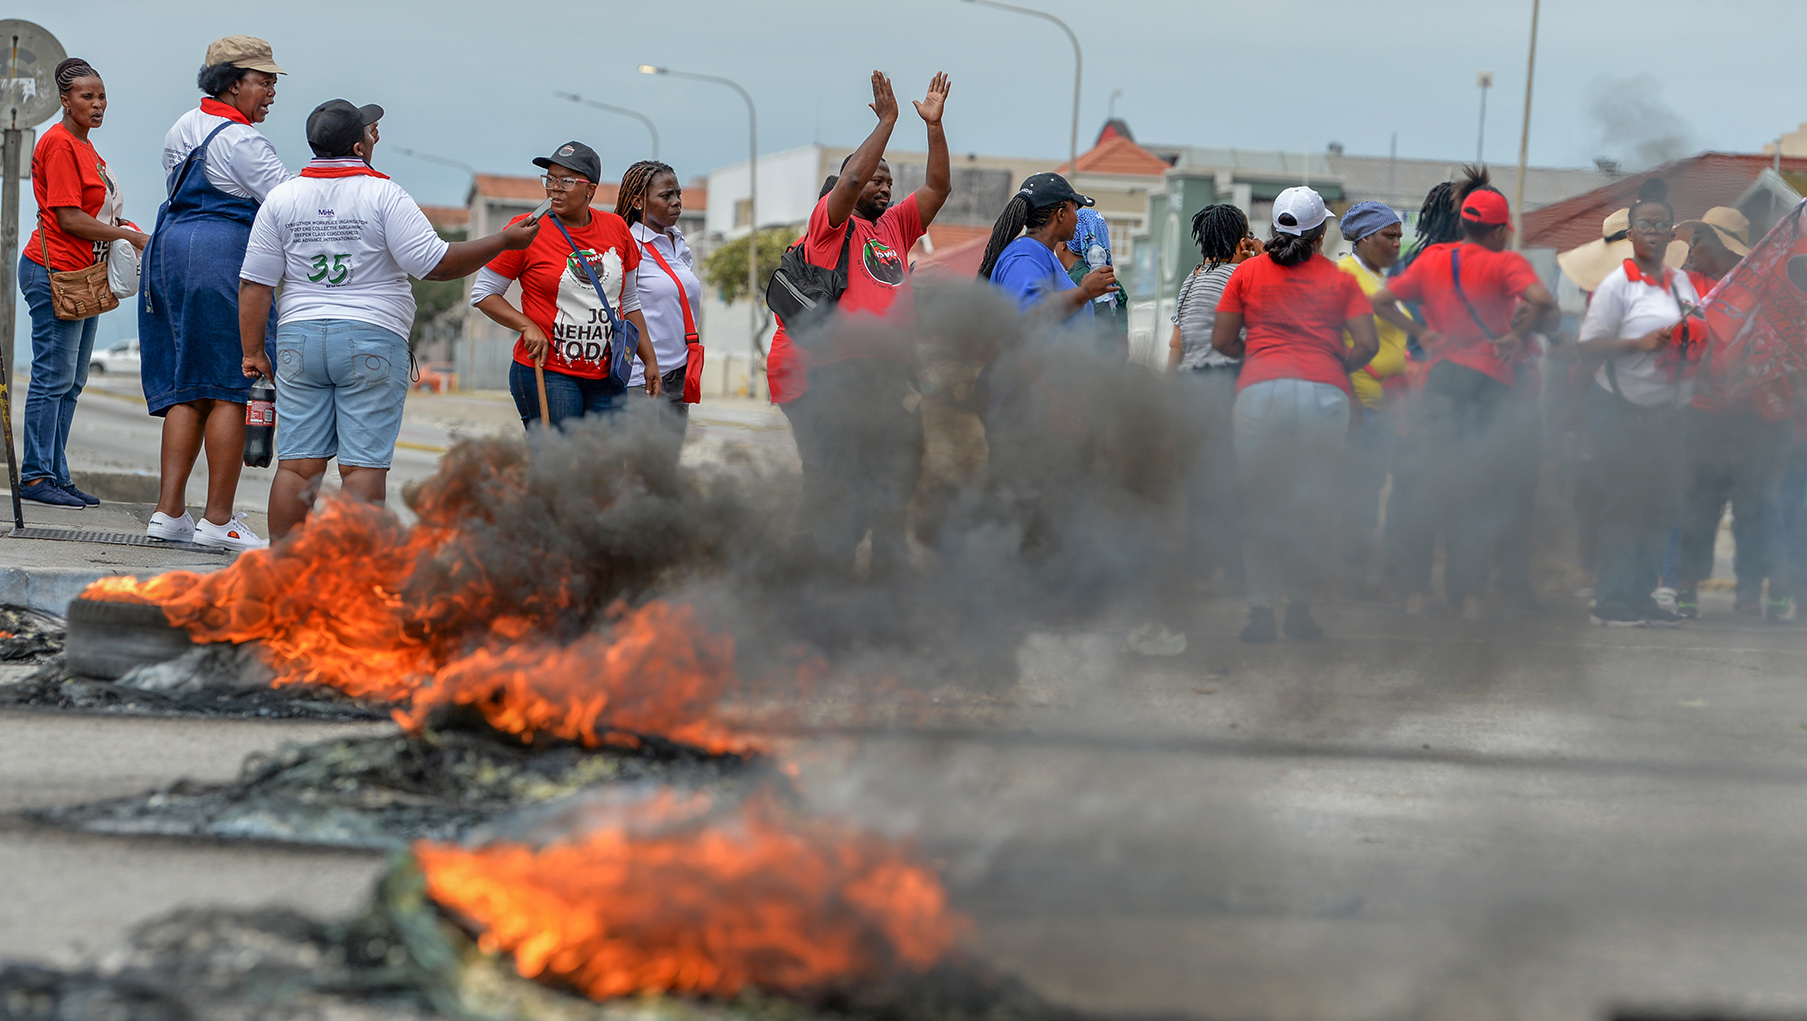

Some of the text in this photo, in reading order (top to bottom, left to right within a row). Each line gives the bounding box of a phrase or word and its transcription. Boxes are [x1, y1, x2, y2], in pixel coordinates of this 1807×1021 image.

[306, 253, 352, 284] 35
[553, 323, 615, 340] NEHAW
[551, 337, 612, 360] TODA
